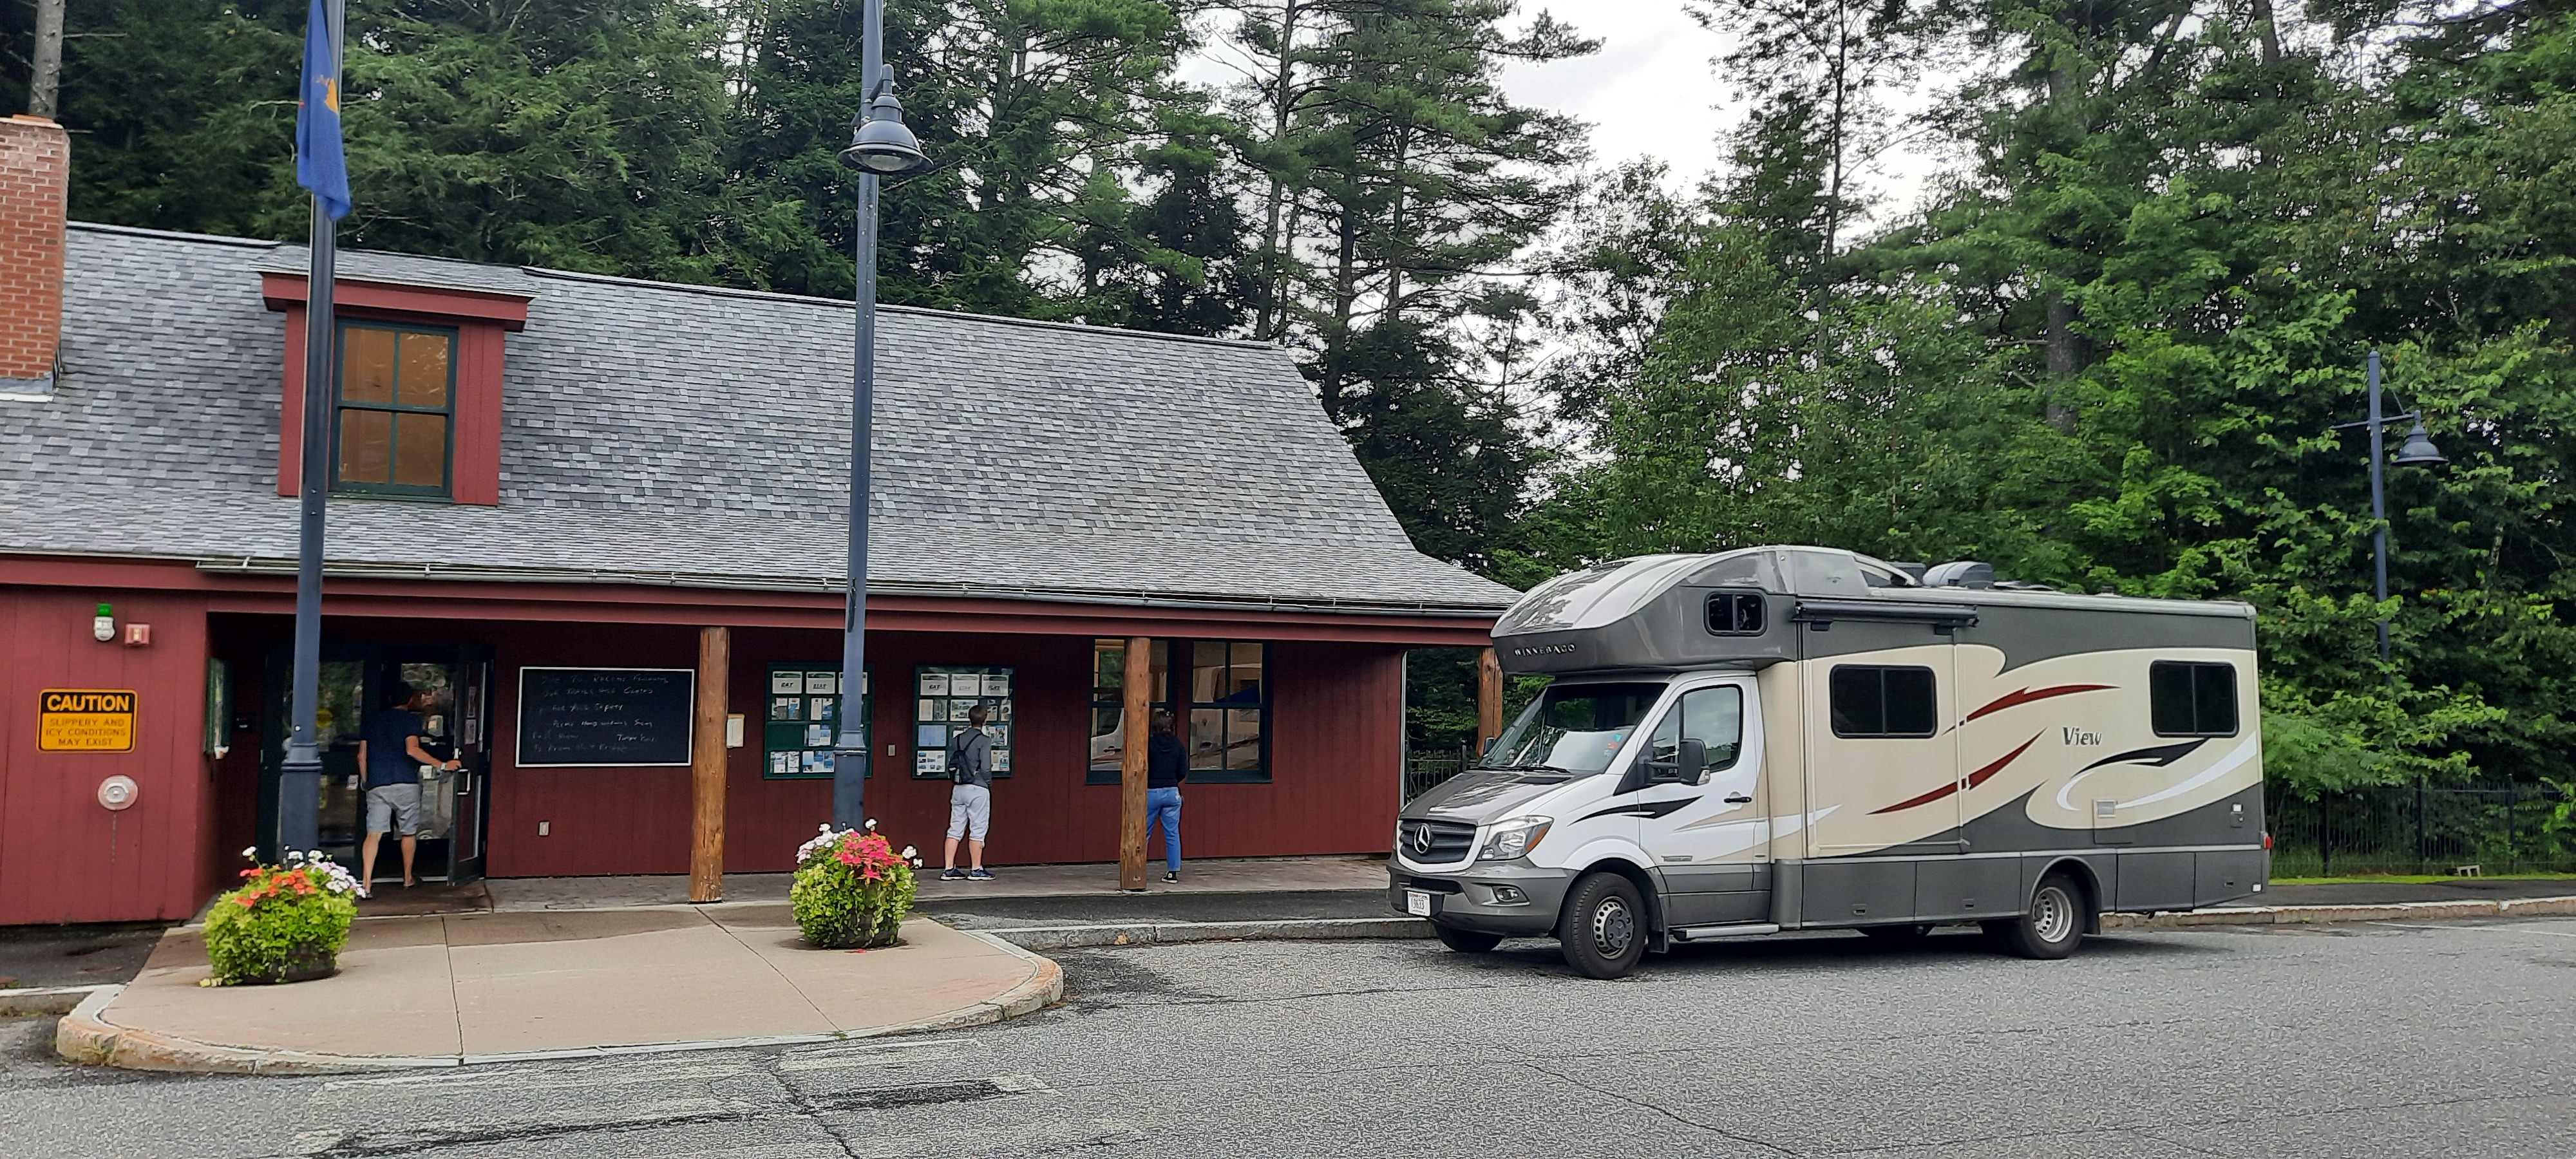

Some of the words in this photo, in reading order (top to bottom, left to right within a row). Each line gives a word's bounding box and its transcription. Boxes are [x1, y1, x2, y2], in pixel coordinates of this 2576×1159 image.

[1514, 644, 1575, 656] WINNEBAGO
[46, 694, 129, 711] CAUTION
[50, 718, 99, 726] SLIPPERY
[103, 718, 124, 726] AND
[2063, 727, 2102, 745] View
